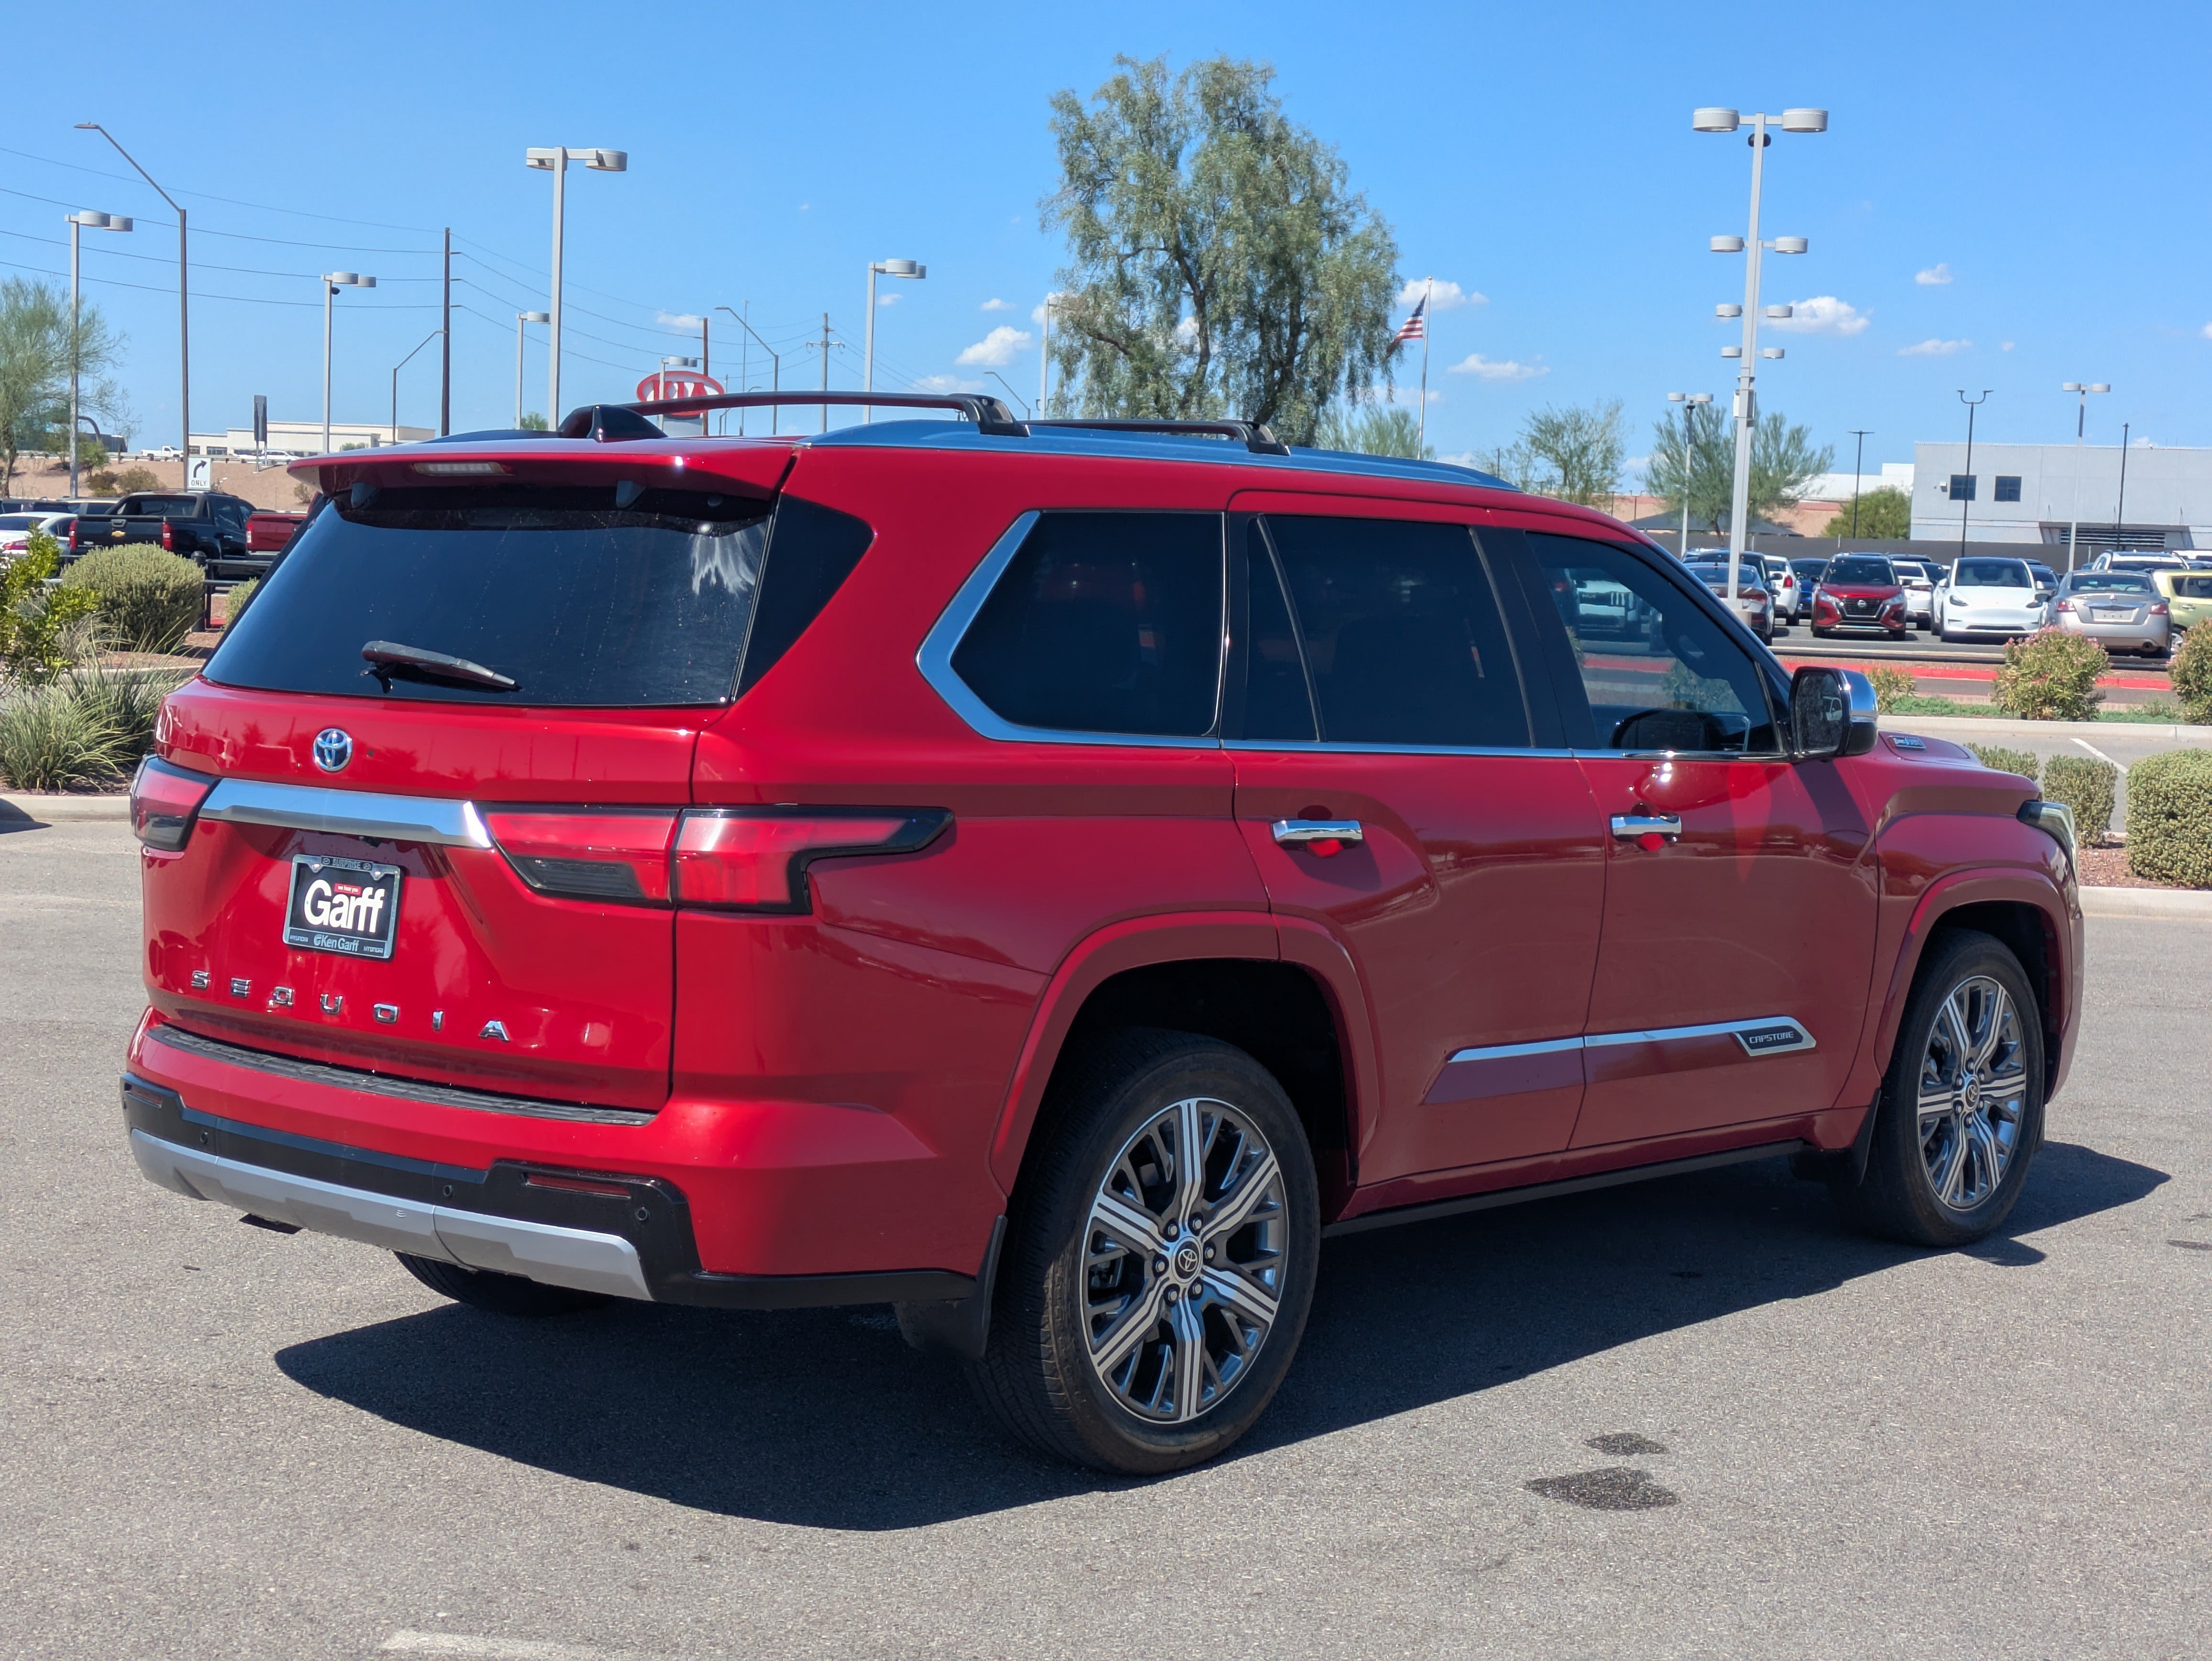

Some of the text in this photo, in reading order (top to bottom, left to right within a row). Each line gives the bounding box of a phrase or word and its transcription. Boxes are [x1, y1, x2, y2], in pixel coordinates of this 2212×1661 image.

[332, 858, 361, 869] SURPRISE
[304, 879, 385, 933] Garff
[338, 938, 360, 952] Garff
[191, 969, 510, 1041] SEQUOIA
[1749, 1031, 1794, 1044] CAPSTONE
